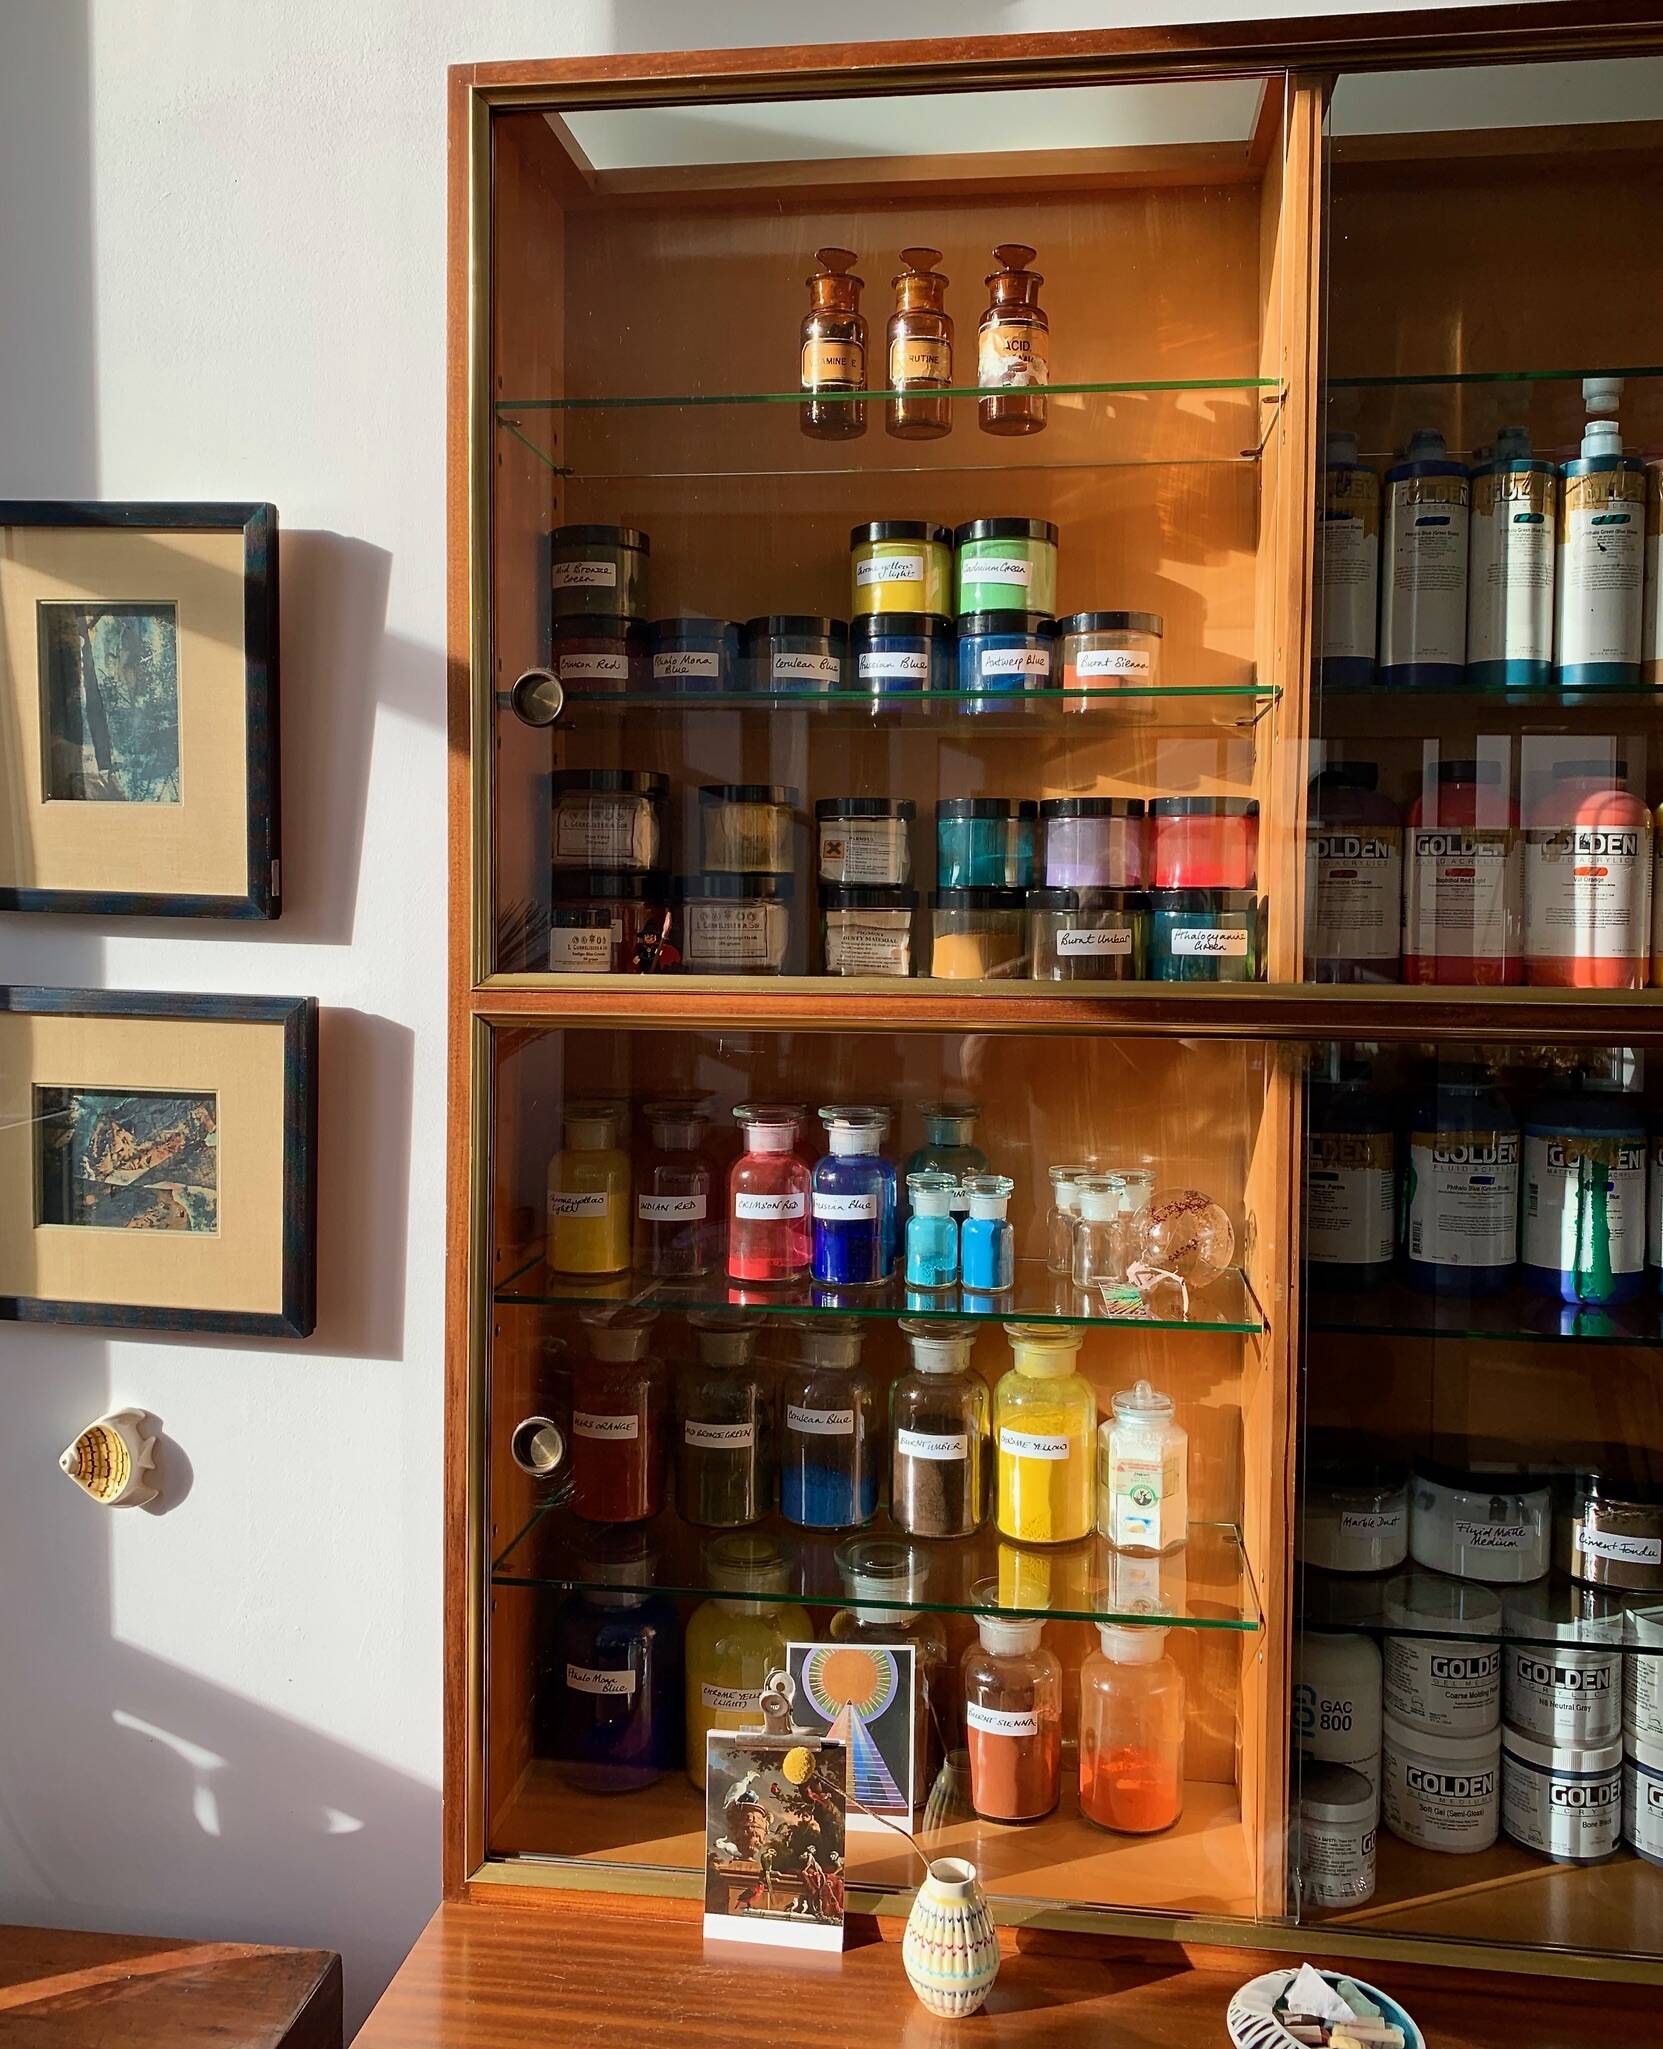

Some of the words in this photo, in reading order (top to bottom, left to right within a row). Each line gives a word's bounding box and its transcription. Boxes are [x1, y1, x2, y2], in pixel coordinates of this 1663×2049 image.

[909, 354, 939, 365] RUTINE
[597, 659, 621, 670] Red
[775, 657, 815, 669] Cerulean
[819, 657, 839, 671] Blue
[900, 656, 928, 669] Blue
[985, 655, 1023, 671] Antwerp
[1026, 654, 1046, 666] Blue
[1080, 655, 1112, 669] Burnt
[1114, 657, 1149, 669] Sienna
[1308, 836, 1389, 858] OLDEN
[1060, 932, 1096, 946] Burnt
[1193, 940, 1227, 951] Green
[1433, 1145, 1518, 1165] GOLDEN
[1547, 1144, 1641, 1169] GOEN
[674, 1200, 696, 1211] RED
[738, 1200, 782, 1210] CRIMSON
[782, 1199, 799, 1210] RED
[847, 1199, 872, 1210] Blue
[826, 1413, 852, 1424] Blue
[1343, 1515, 1375, 1528] Marble
[1376, 1515, 1401, 1527] Dust
[1456, 1521, 1492, 1537] Fluid
[1493, 1526, 1526, 1538] Matte
[1470, 1536, 1519, 1547] Medium
[1579, 1531, 1618, 1550] Ciment
[1618, 1542, 1658, 1557] Fondu
[1431, 1651, 1500, 1680] GOLDE
[1517, 1655, 1611, 1690] GOLDEN
[602, 1683, 627, 1692] Blue
[703, 1687, 738, 1699] CHROME
[738, 1692, 763, 1701] YELL
[1445, 1690, 1468, 1699] Coarse
[1320, 1700, 1353, 1714] GAC
[1549, 1700, 1575, 1711] Neutral
[997, 1718, 1037, 1728] SIENNA
[1320, 1713, 1353, 1731] 800
[1407, 1765, 1494, 1798] GOLDEN
[1418, 1804, 1434, 1815] Soft
[1435, 1807, 1446, 1815] Gel
[1446, 1808, 1485, 1819] (Semi-Gloss)
[1582, 1820, 1599, 1829] Bone
